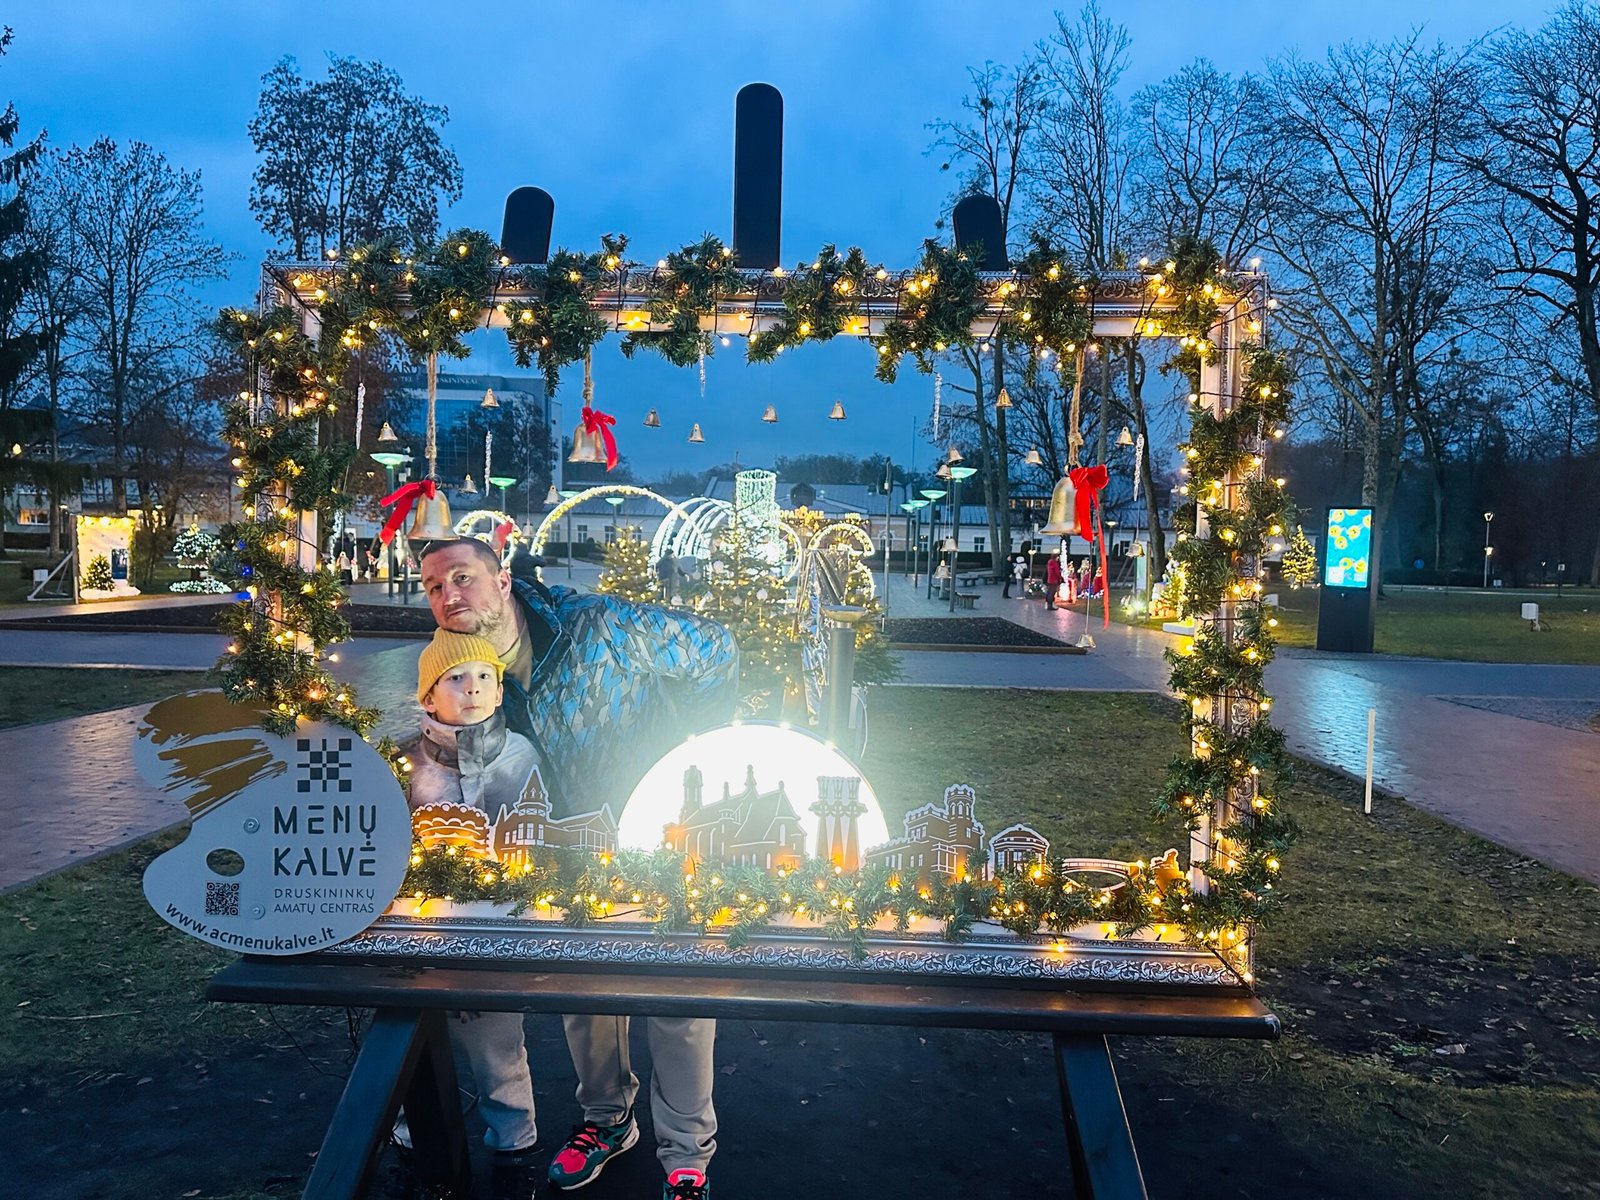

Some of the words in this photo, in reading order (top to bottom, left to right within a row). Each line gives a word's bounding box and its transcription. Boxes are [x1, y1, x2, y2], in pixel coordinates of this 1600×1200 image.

[274, 805, 376, 839] MENŲ
[273, 841, 376, 876] KALVĖ
[273, 903, 315, 915] AMATŲ
[320, 902, 374, 913] CENTRAS
[274, 888, 375, 900] DRUSKININKŲ
[166, 903, 336, 951] www.acmenukalve.lt
